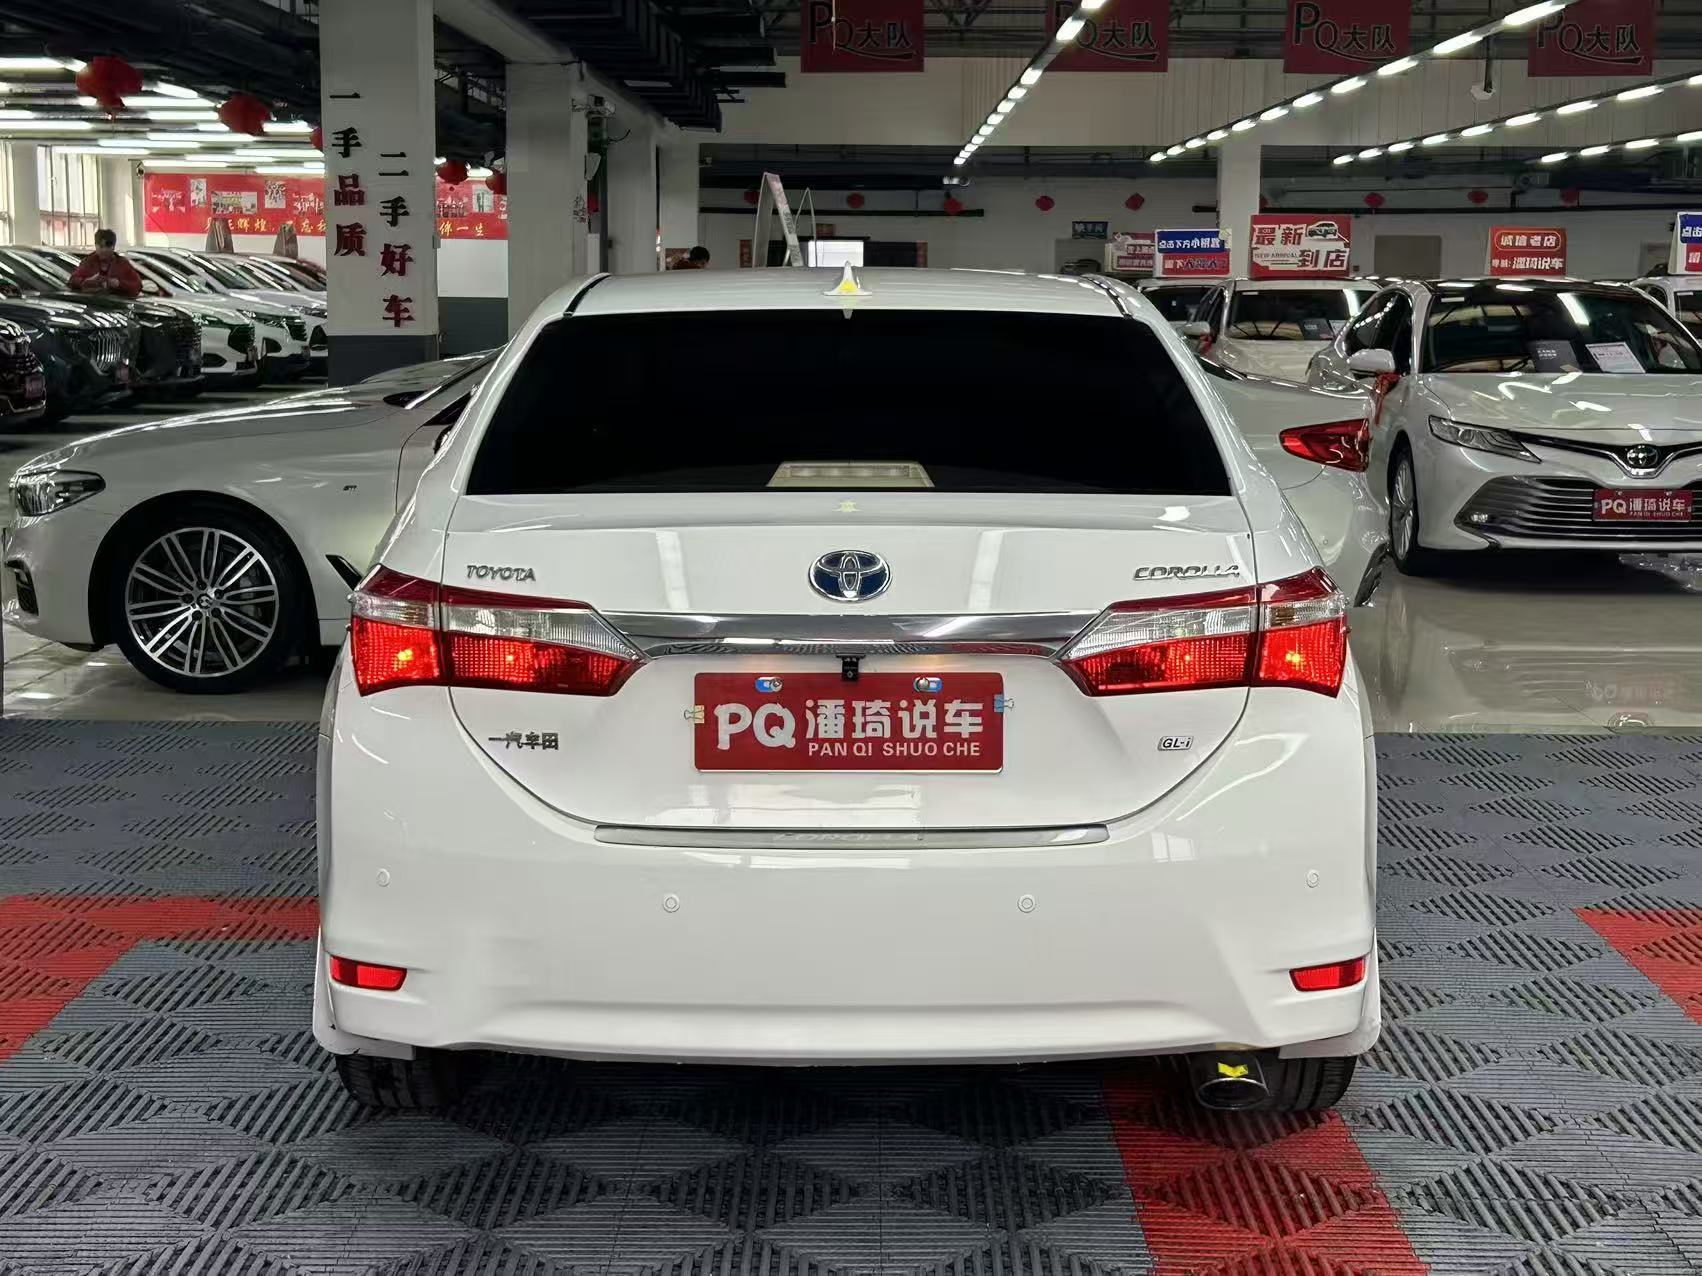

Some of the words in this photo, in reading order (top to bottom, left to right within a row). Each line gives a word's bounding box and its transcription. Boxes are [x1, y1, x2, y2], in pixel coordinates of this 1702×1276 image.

[329, 92, 367, 257] 一手品质
[378, 151, 415, 328] 二手好车
[1255, 226, 1305, 246] 最新
[1297, 249, 1347, 269] 到店
[466, 564, 537, 582] TOYOTA
[1133, 564, 1241, 581] COROLLA
[713, 702, 797, 750] PQ
[805, 699, 985, 739] 潘琦说车
[808, 742, 848, 757] PAN
[853, 742, 873, 757] QI
[882, 742, 937, 757] SHUO
[943, 742, 981, 757] CHE
[1162, 737, 1191, 749] GL-i
